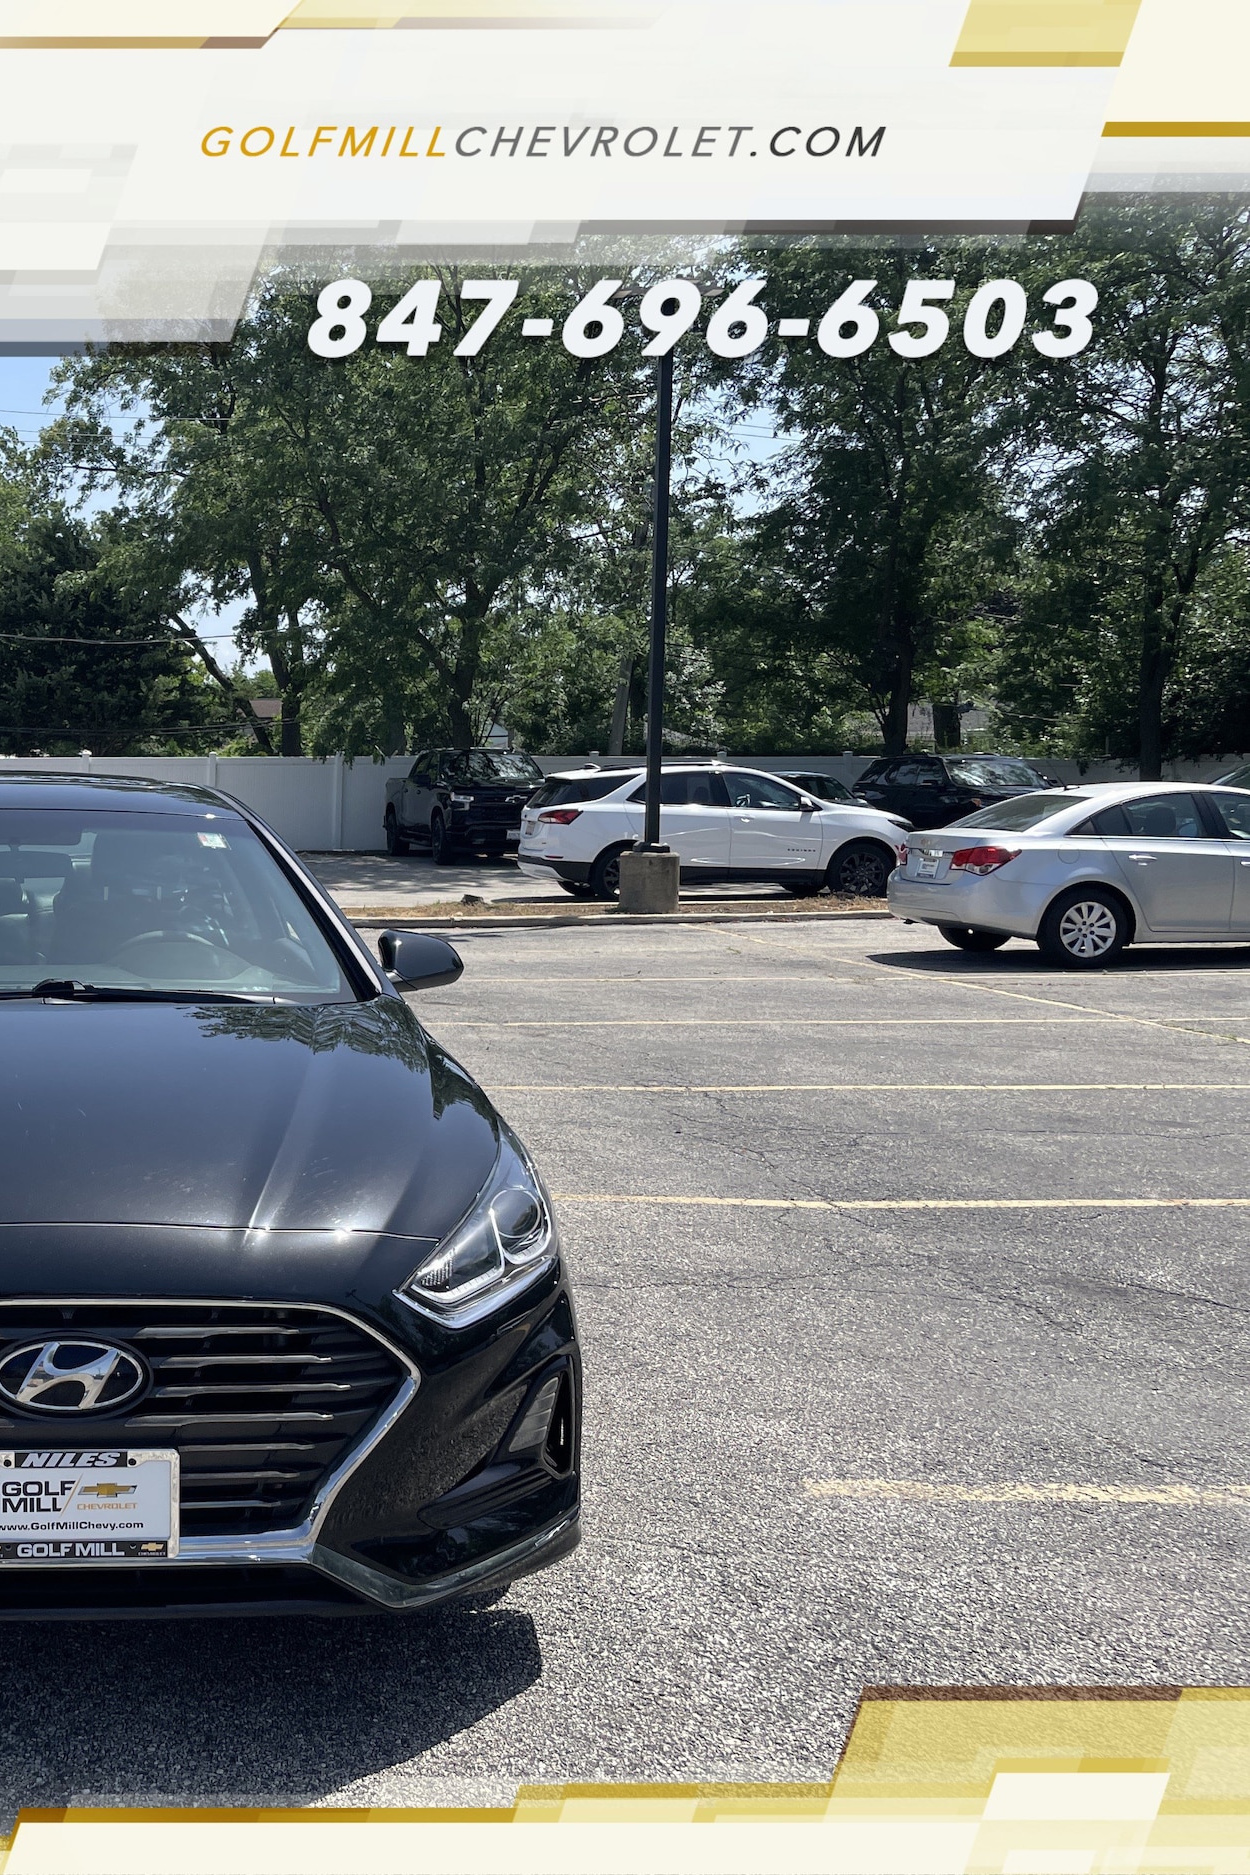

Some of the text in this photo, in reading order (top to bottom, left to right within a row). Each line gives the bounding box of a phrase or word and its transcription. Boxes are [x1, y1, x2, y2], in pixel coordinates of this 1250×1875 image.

[21, 1452, 121, 1468] NILES
[2, 1480, 76, 1496] GOLF
[2, 1497, 62, 1513] MILL
[76, 1503, 138, 1511] CHEVROLET
[17, 1542, 125, 1558] GOLF MILL
